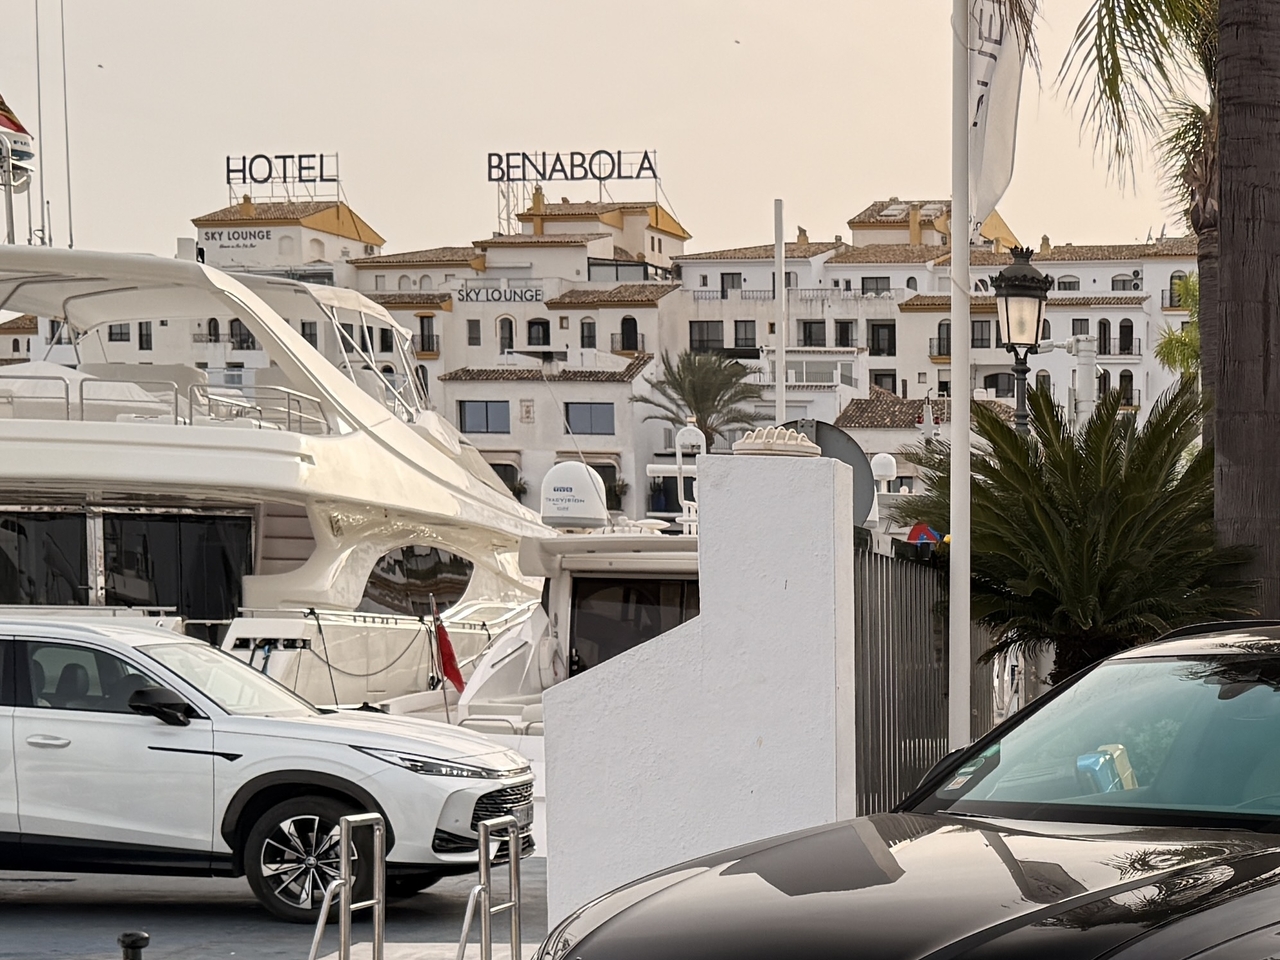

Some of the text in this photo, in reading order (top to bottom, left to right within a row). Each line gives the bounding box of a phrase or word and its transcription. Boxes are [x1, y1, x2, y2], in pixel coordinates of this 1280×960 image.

[226, 154, 337, 184] HOTEL
[488, 149, 658, 182] BENABOLA
[204, 230, 272, 241] SKY LOUNGE
[457, 288, 542, 302] SKY LOUNGE
